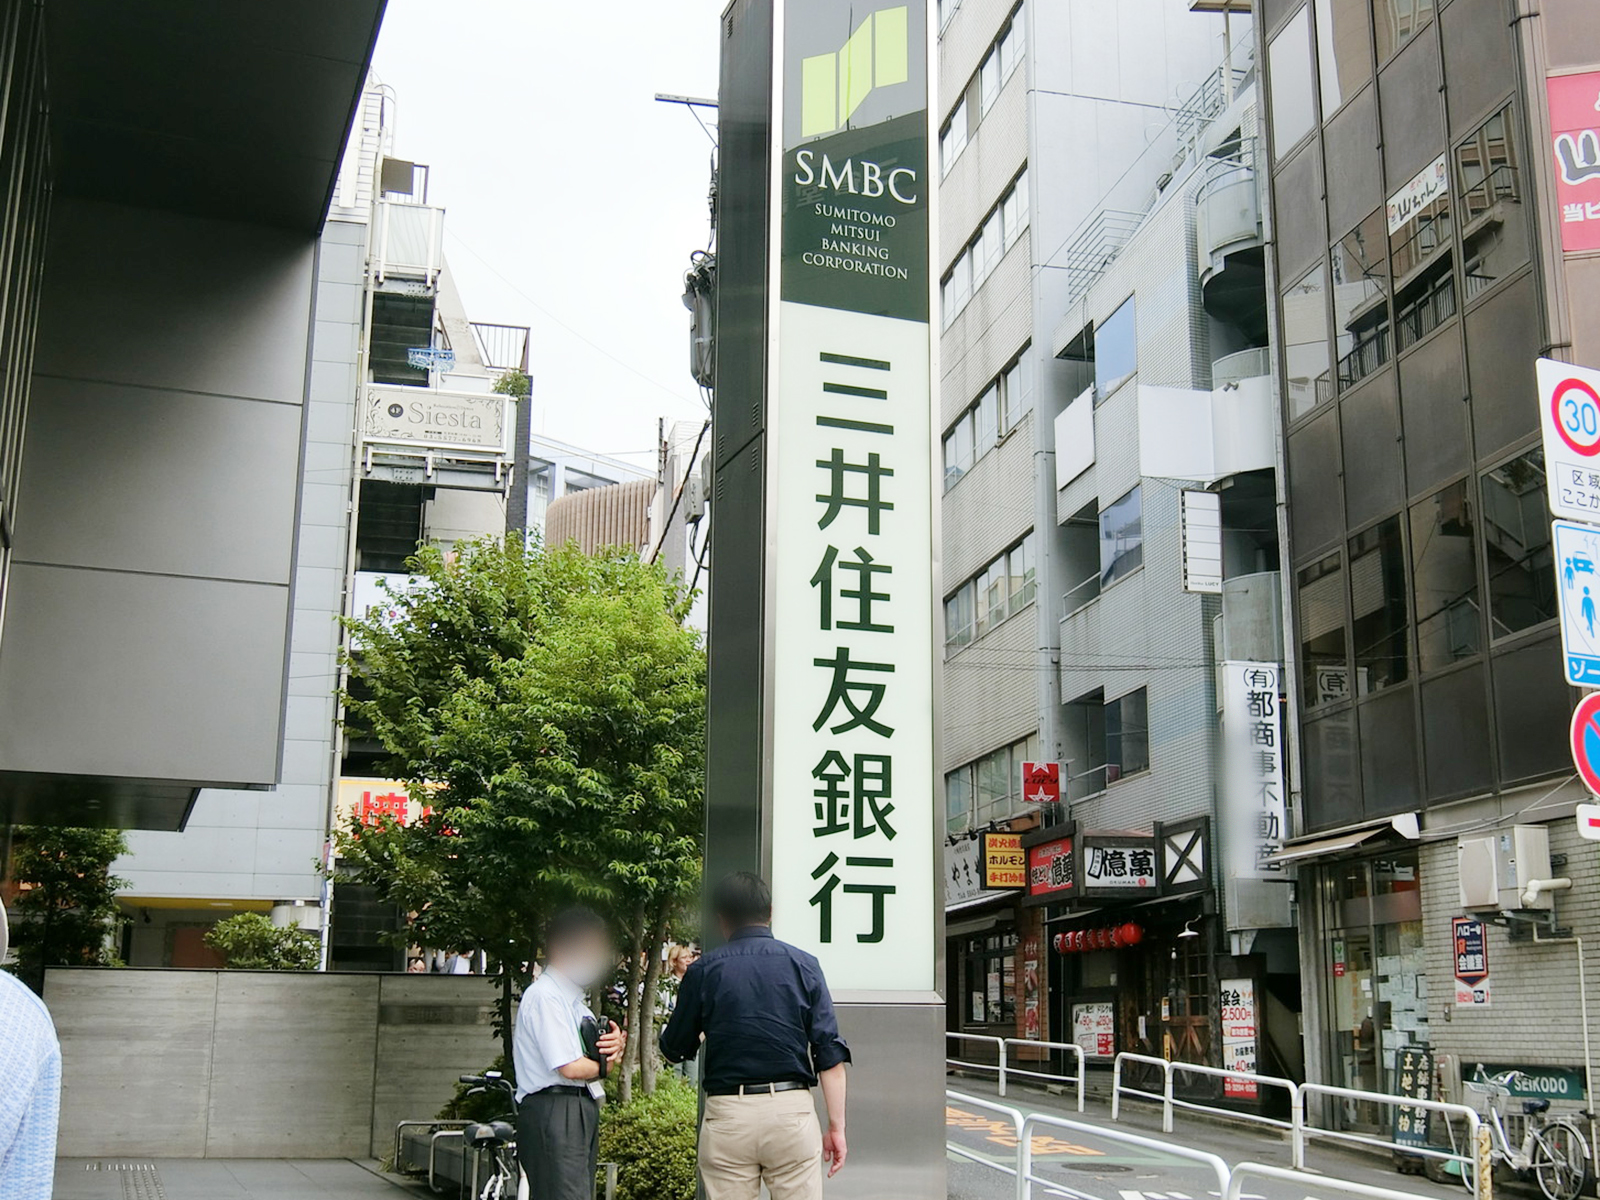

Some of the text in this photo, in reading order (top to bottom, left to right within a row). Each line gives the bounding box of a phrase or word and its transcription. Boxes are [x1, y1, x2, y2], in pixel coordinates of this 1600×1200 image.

[795, 150, 917, 204] SMBC
[815, 203, 896, 228] SUMITOMO
[830, 223, 880, 241] MITSUI
[822, 238, 889, 260] BANKING
[802, 252, 908, 280] CORPORATION
[408, 402, 481, 429] Siesta
[1565, 399, 1597, 436] 30
[809, 352, 897, 943] 三井住友銀行
[1102, 849, 1154, 878] 億萬
[1221, 989, 1240, 1006] 宴会
[1514, 1077, 1568, 1094] SEIKODO
